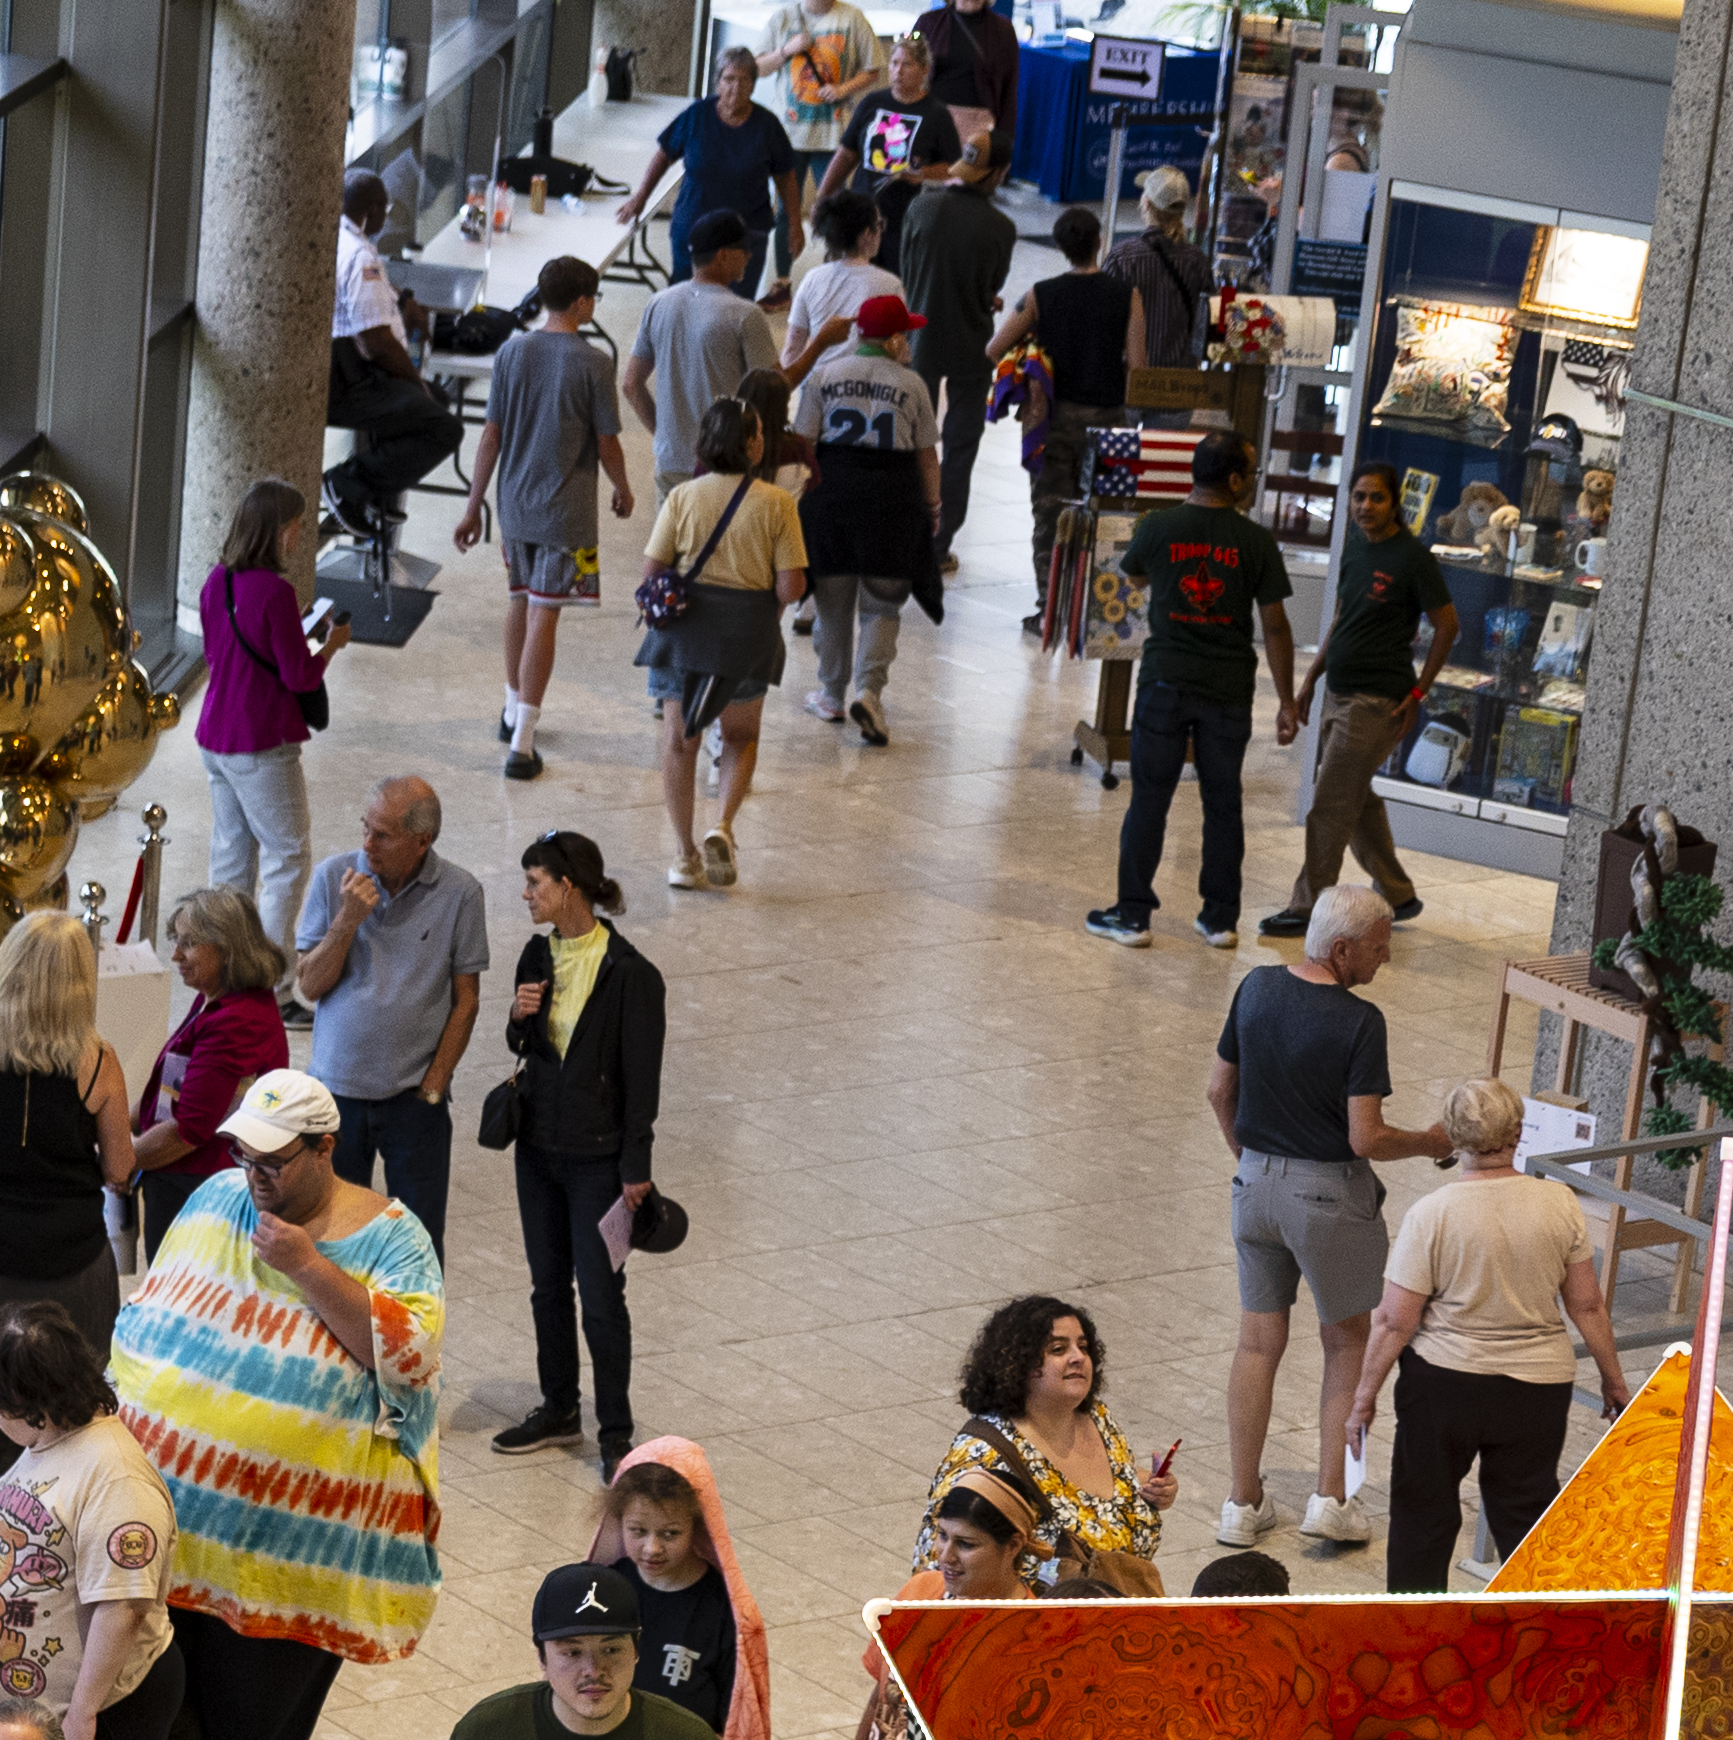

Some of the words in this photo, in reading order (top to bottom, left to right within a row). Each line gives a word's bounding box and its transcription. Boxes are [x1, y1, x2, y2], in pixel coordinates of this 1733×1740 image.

[1106, 46, 1152, 64] EXIT
[821, 380, 908, 406] MCGONIGLE
[823, 406, 896, 448] 21
[1170, 543, 1211, 562] TROOP
